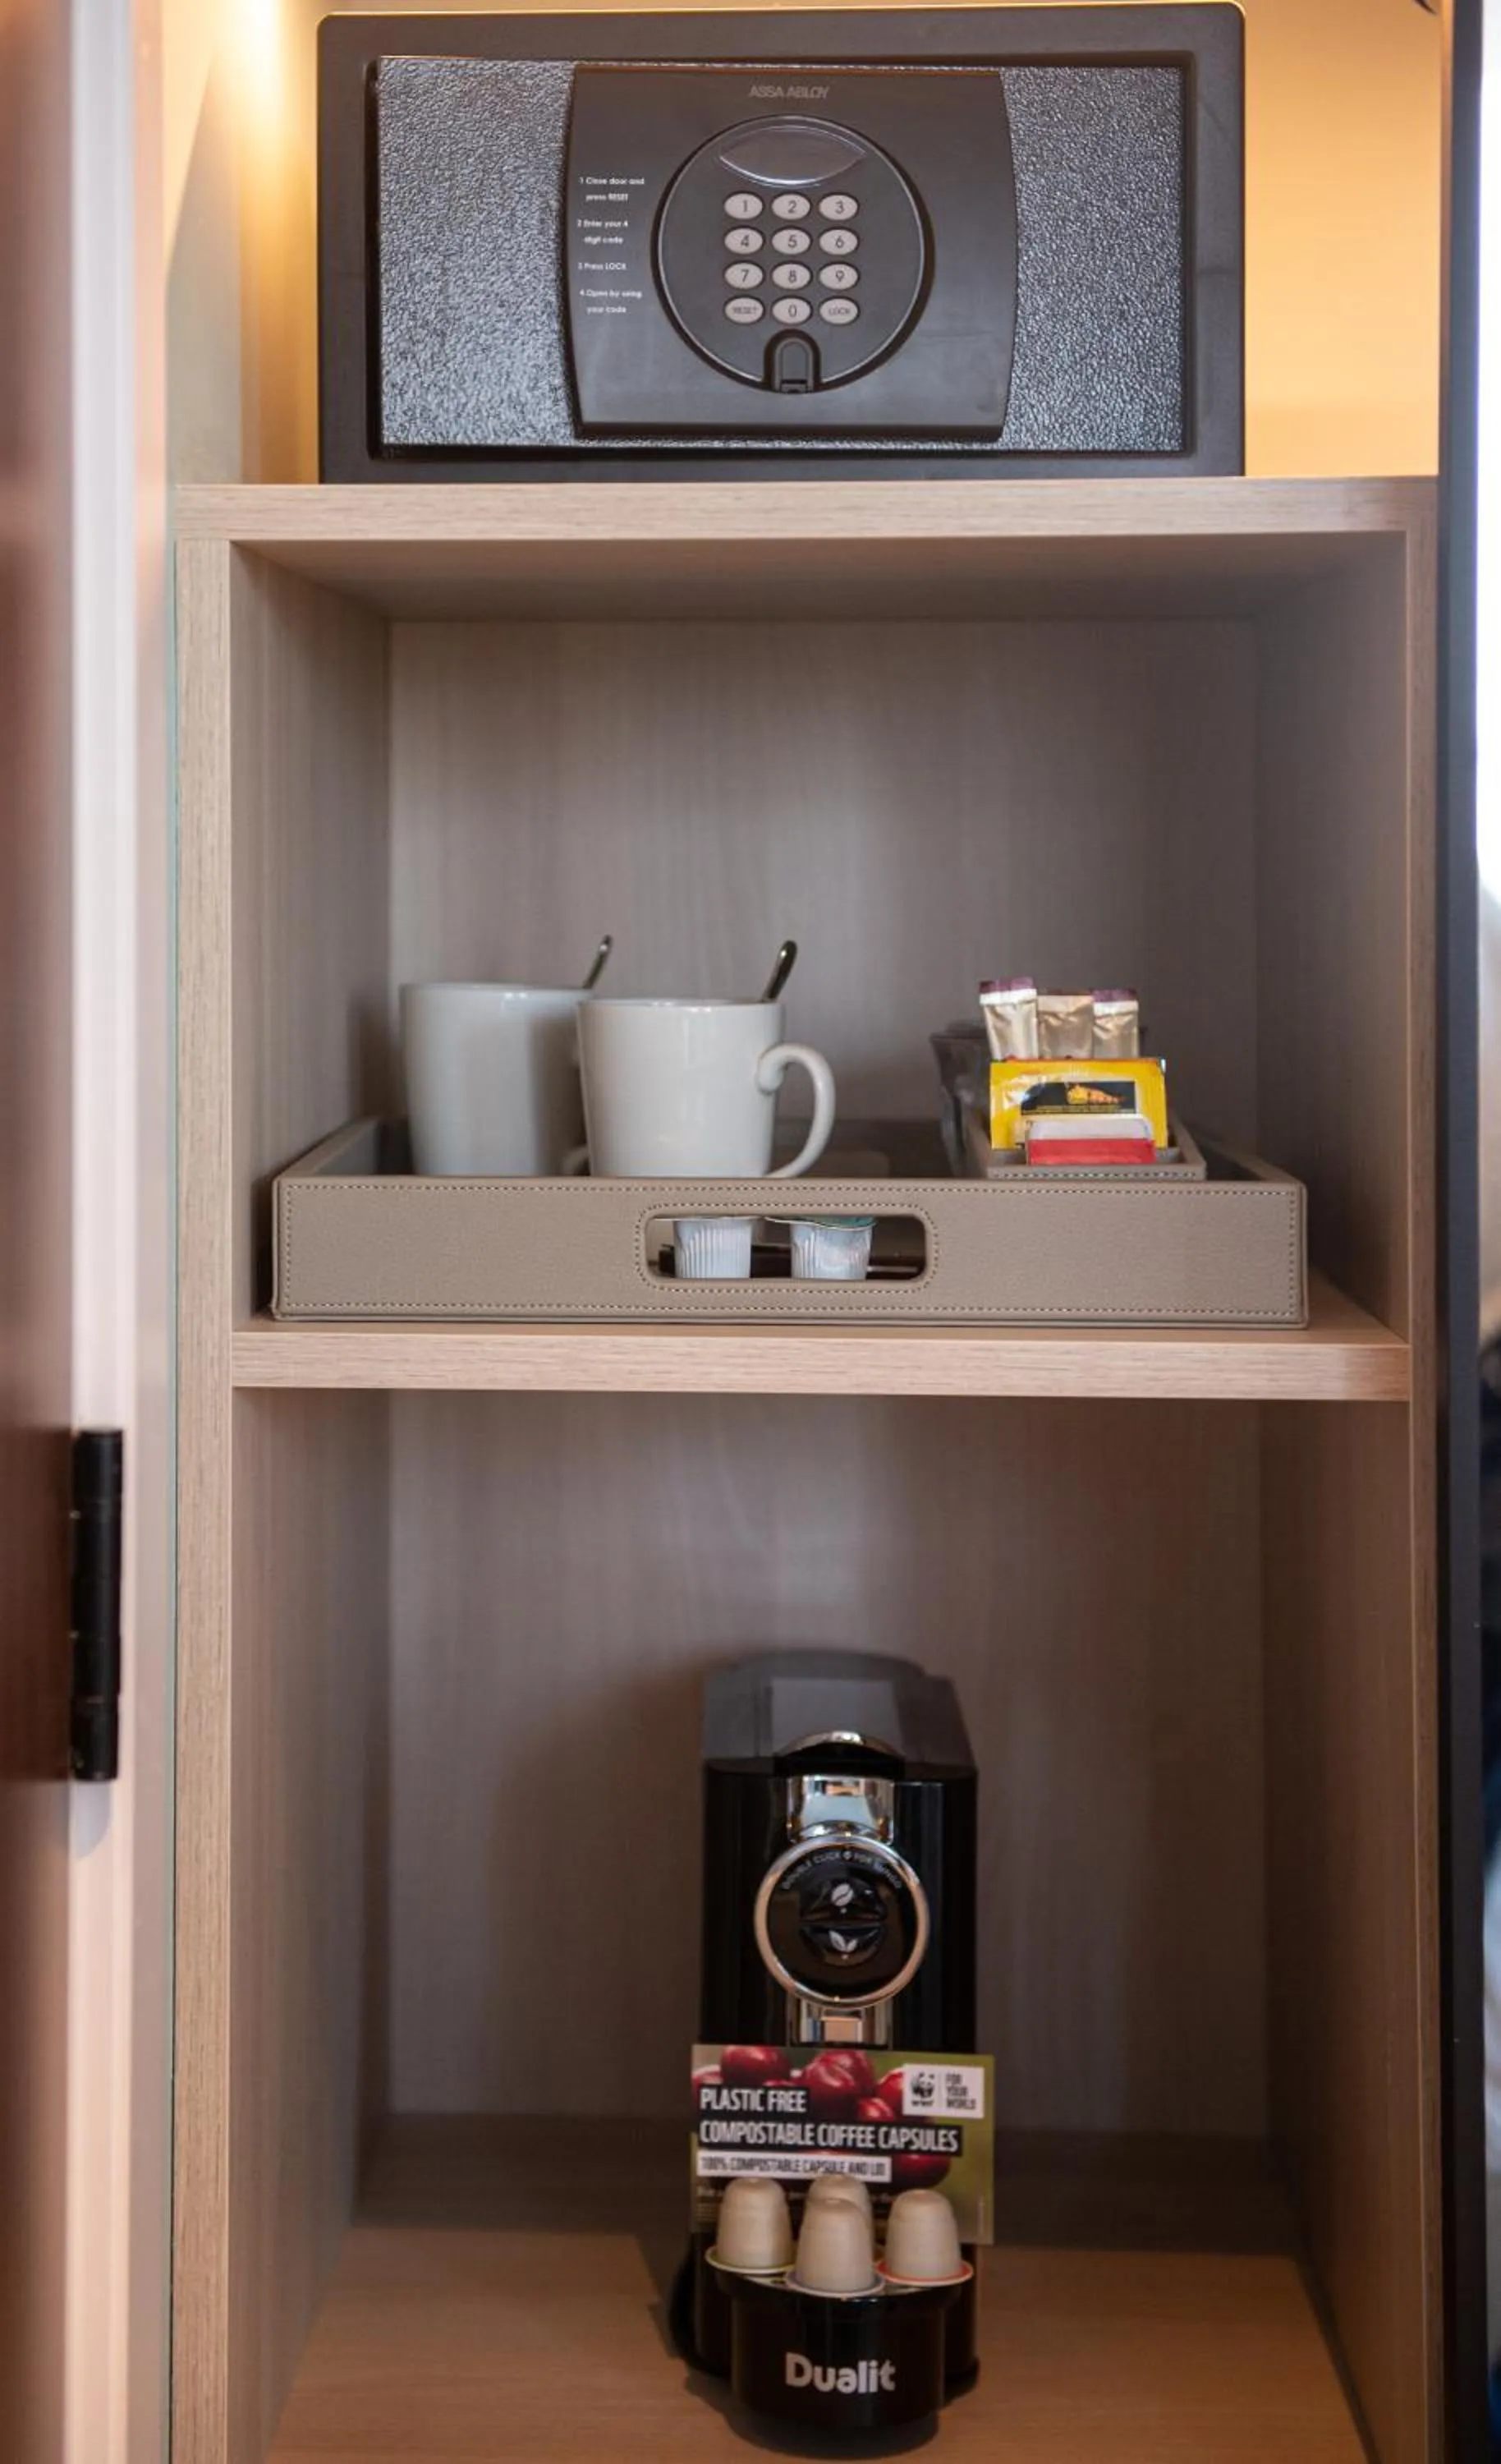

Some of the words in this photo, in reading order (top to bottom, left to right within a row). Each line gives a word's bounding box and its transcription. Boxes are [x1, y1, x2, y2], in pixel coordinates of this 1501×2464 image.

[748, 85, 784, 98] ASSA
[787, 85, 830, 99] ABLOY
[585, 177, 607, 185] Close
[609, 177, 627, 185] door
[629, 177, 645, 185] and
[608, 193, 628, 201] RESET
[742, 200, 748, 213] 1
[787, 200, 797, 214] 2
[834, 200, 844, 214] 3
[584, 218, 602, 228] Enter
[605, 220, 622, 229] your
[602, 236, 623, 244] code
[741, 234, 749, 247] 4
[787, 234, 797, 248] 5
[834, 235, 844, 249] 6
[584, 262, 604, 270] Press
[605, 262, 627, 270] LOCK
[740, 269, 749, 283] 7
[787, 269, 797, 283] 8
[835, 269, 845, 283] 9
[585, 289, 608, 297] Open
[609, 289, 620, 298] by
[622, 290, 642, 299] using
[587, 306, 604, 315] your
[787, 304, 797, 318] 0
[829, 306, 851, 316] LOCK
[946, 2073, 962, 2085] FOR
[947, 2086, 968, 2097] YOUR
[700, 2087, 765, 2112] PLASTIC
[767, 2090, 807, 2113] FREE
[946, 2098, 977, 2110] WORLD
[700, 2120, 815, 2146] COMPOSTABLE
[817, 2123, 876, 2149] COFFEE
[878, 2126, 959, 2153] CAPSULES
[701, 2157, 728, 2170] 100%
[730, 2158, 801, 2172] COMPOSTABLE
[803, 2159, 847, 2174] CAPSULE
[848, 2161, 867, 2176] AND
[869, 2163, 886, 2177] LID
[785, 2351, 896, 2393] Dualit
